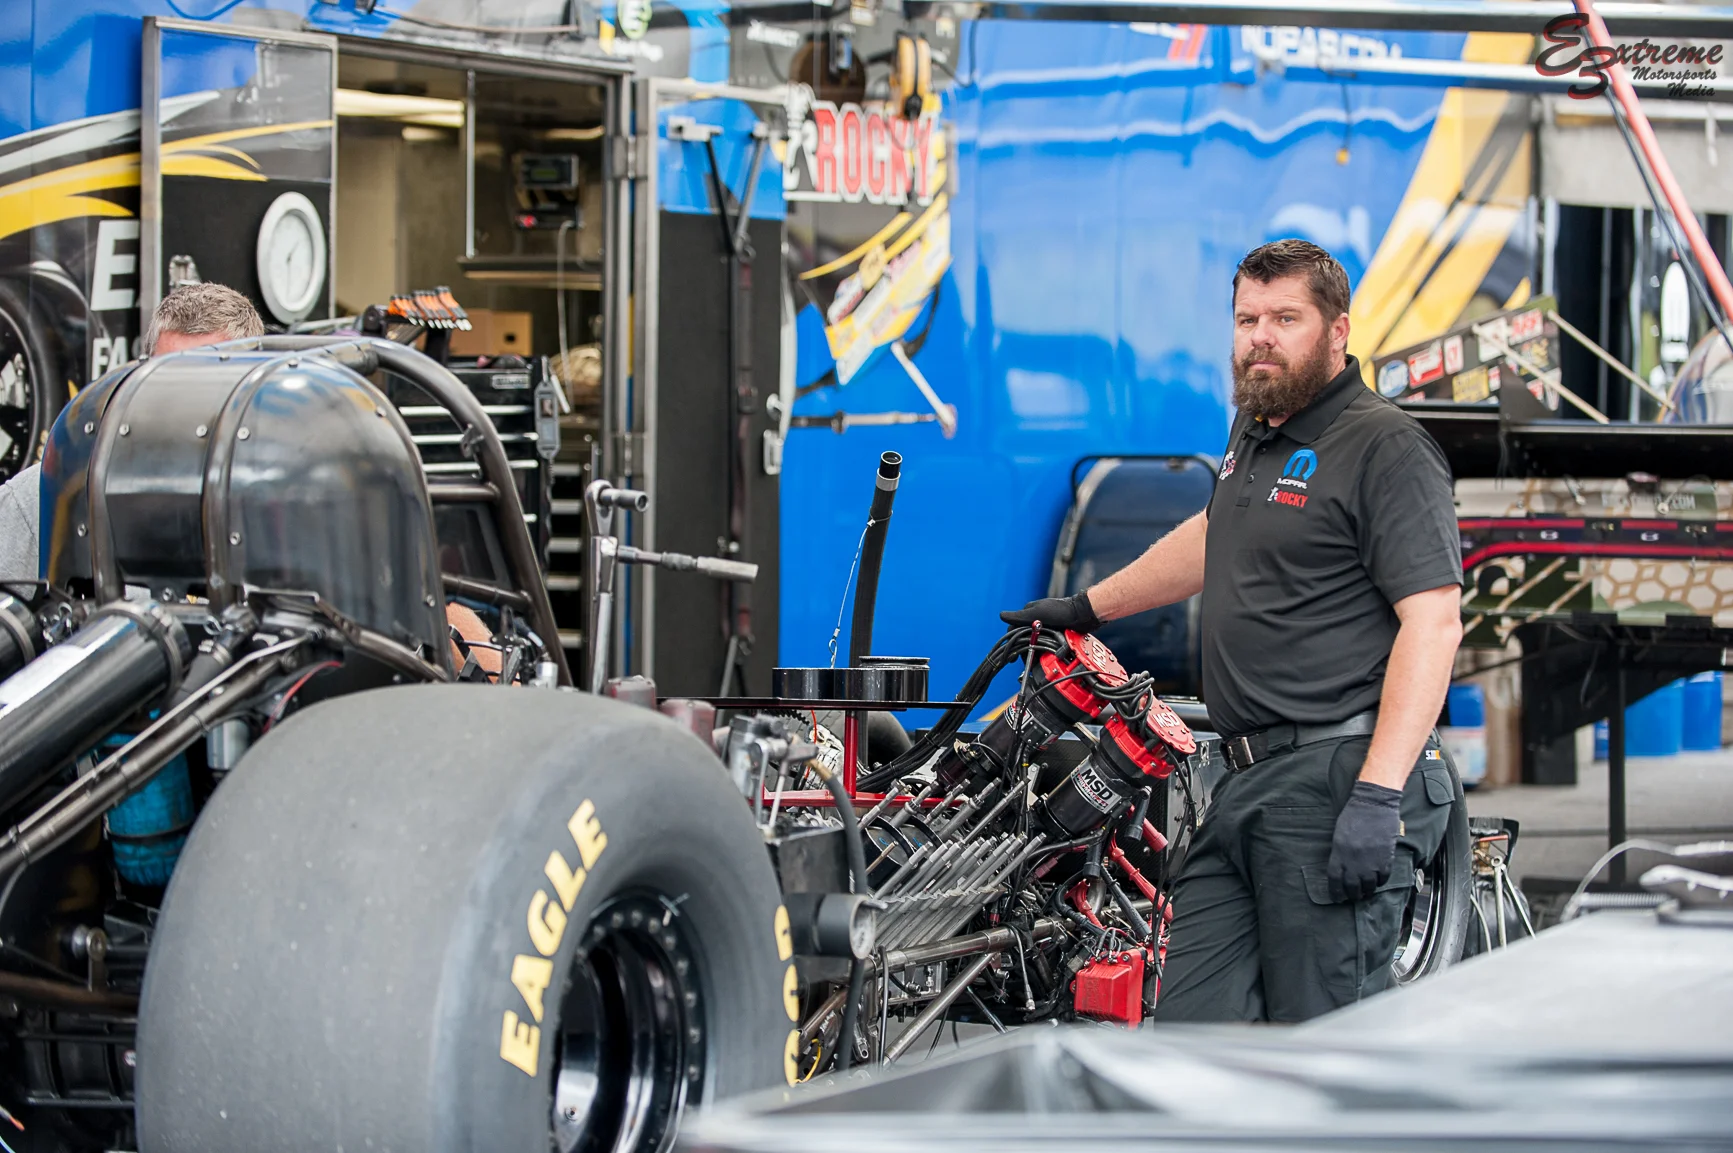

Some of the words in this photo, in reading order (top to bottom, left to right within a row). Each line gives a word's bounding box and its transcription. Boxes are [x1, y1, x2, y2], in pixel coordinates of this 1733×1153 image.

[1277, 478, 1307, 490] MOPAR
[1275, 490, 1308, 508] ROCKY
[1092, 640, 1107, 673] MSD
[1152, 713, 1180, 728] MSD
[1081, 768, 1113, 801] MSD
[500, 798, 608, 1077] EAGLE
